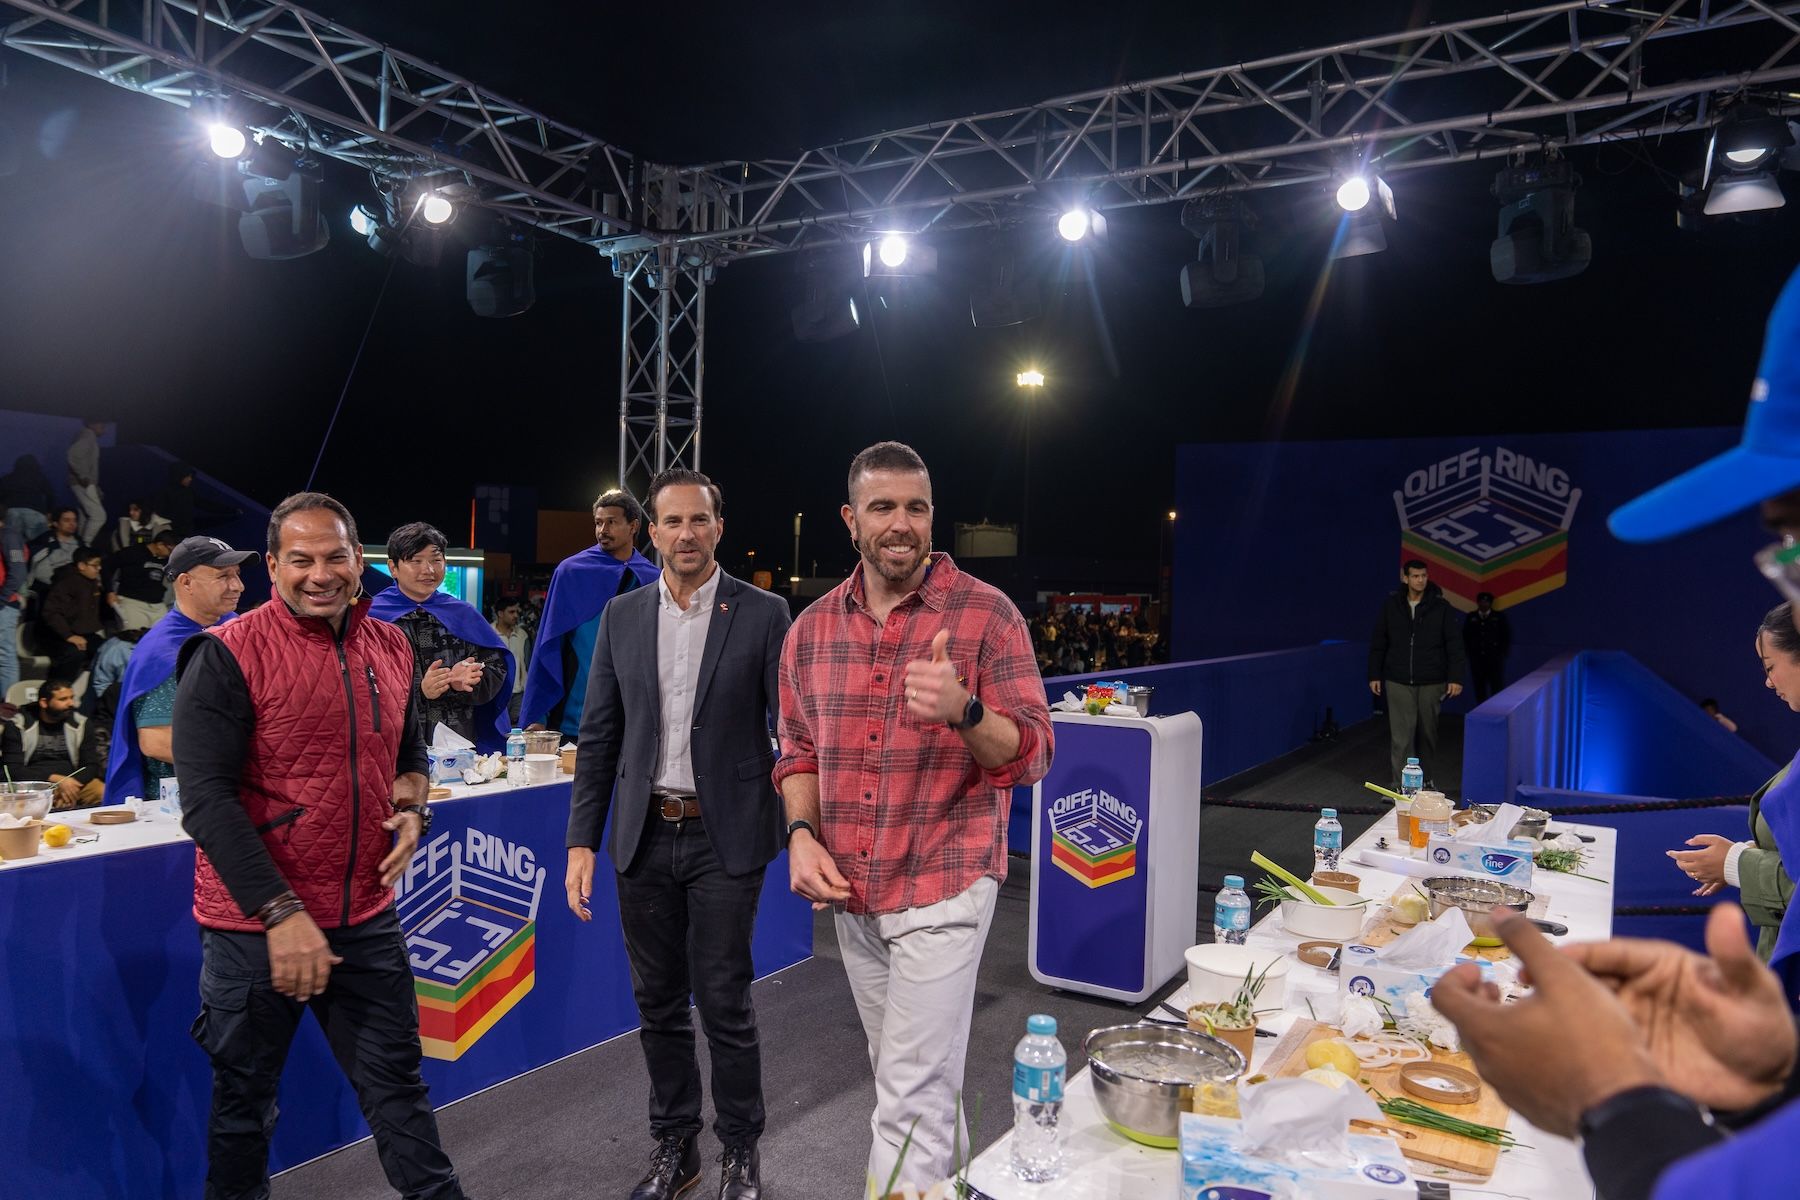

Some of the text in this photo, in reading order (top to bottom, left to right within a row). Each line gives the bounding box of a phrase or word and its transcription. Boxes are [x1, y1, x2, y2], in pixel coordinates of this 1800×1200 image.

[1404, 446, 1570, 498] QIFF RING
[1053, 788, 1137, 824] QIFF RING
[395, 827, 536, 901] IFF RING
